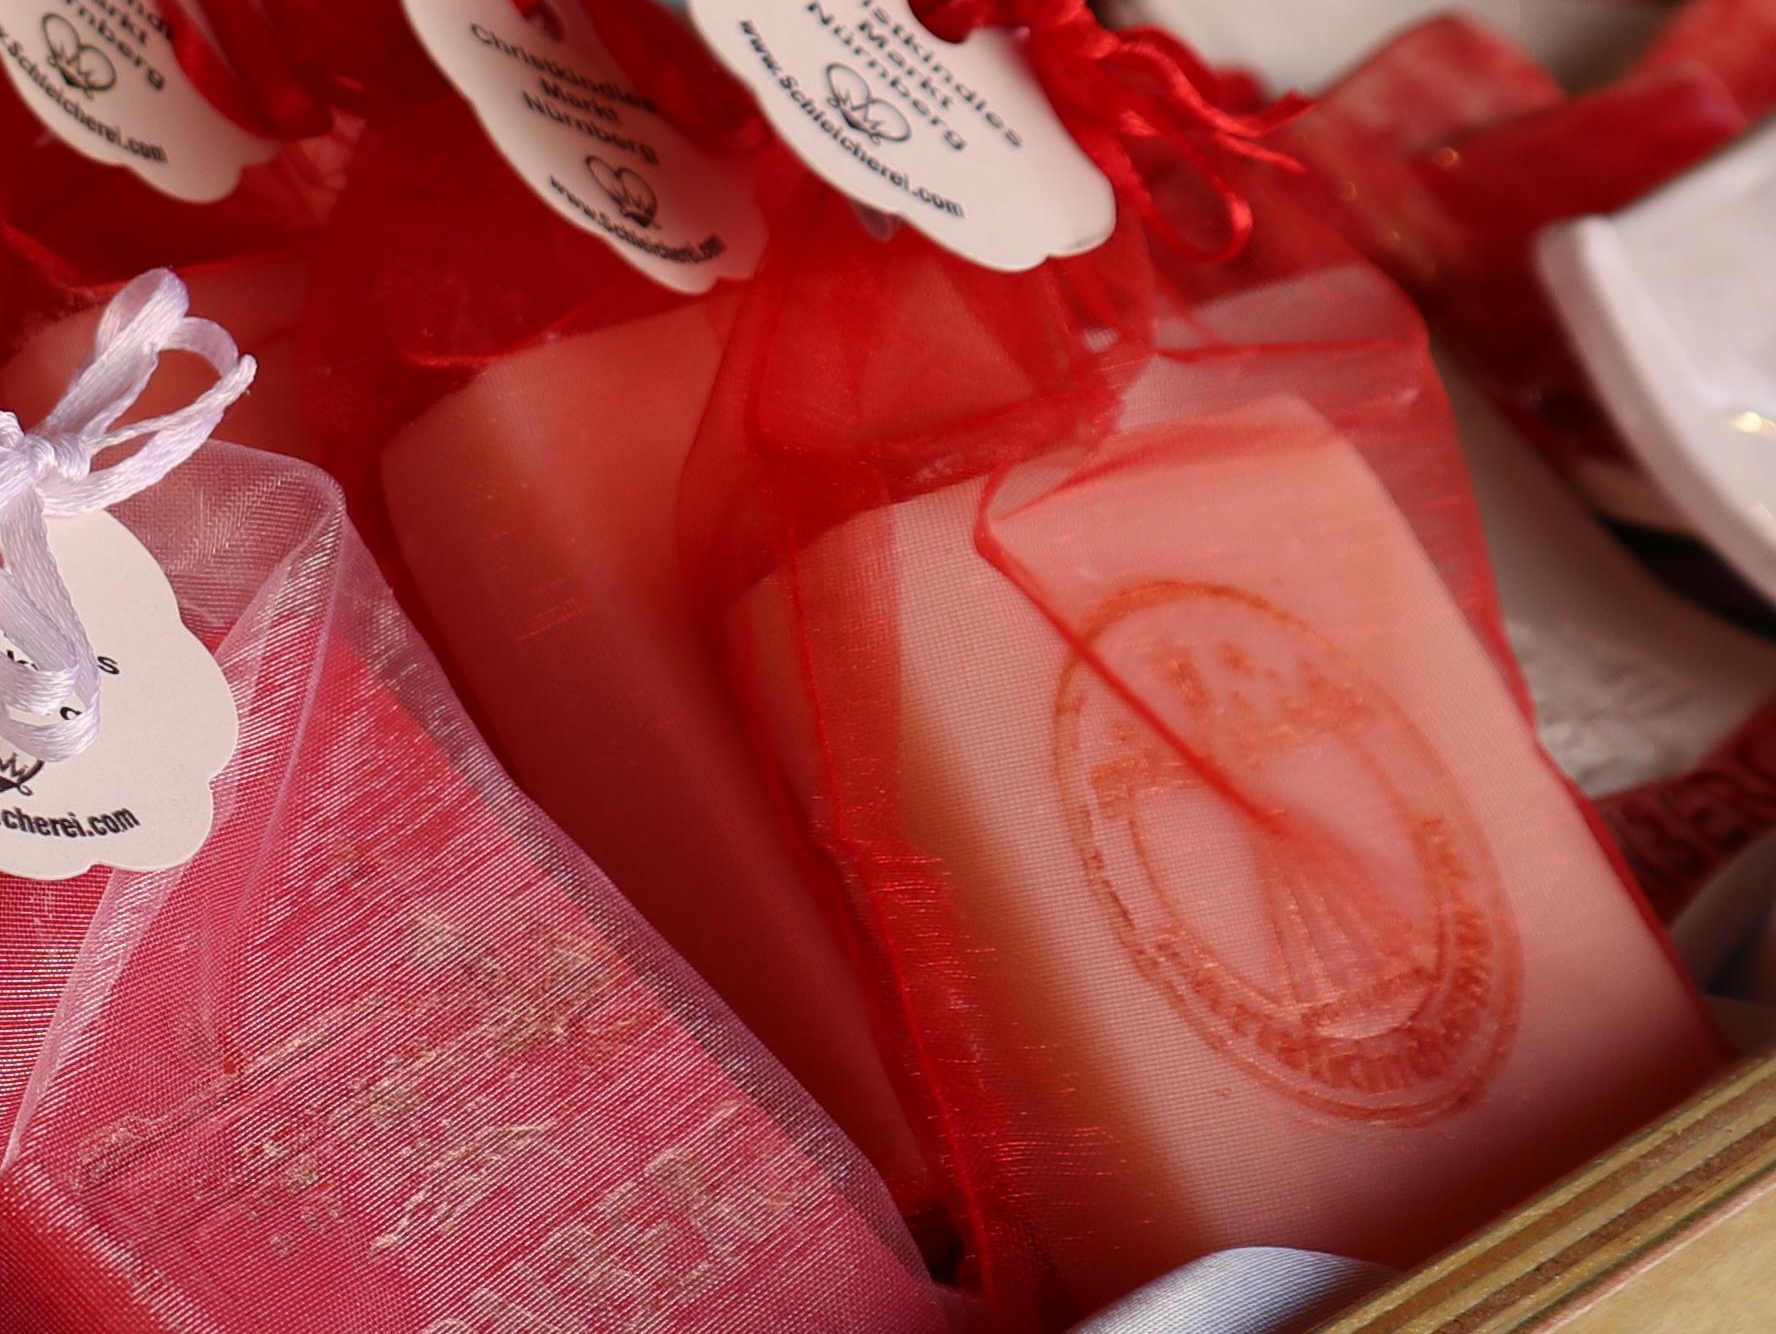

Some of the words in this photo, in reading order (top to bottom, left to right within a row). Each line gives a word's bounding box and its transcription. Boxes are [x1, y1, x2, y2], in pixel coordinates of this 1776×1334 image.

[739, 19, 966, 218] www.Schleicherei.com
[806, 0, 967, 151] Nürnberg
[857, 20, 954, 110] Markt
